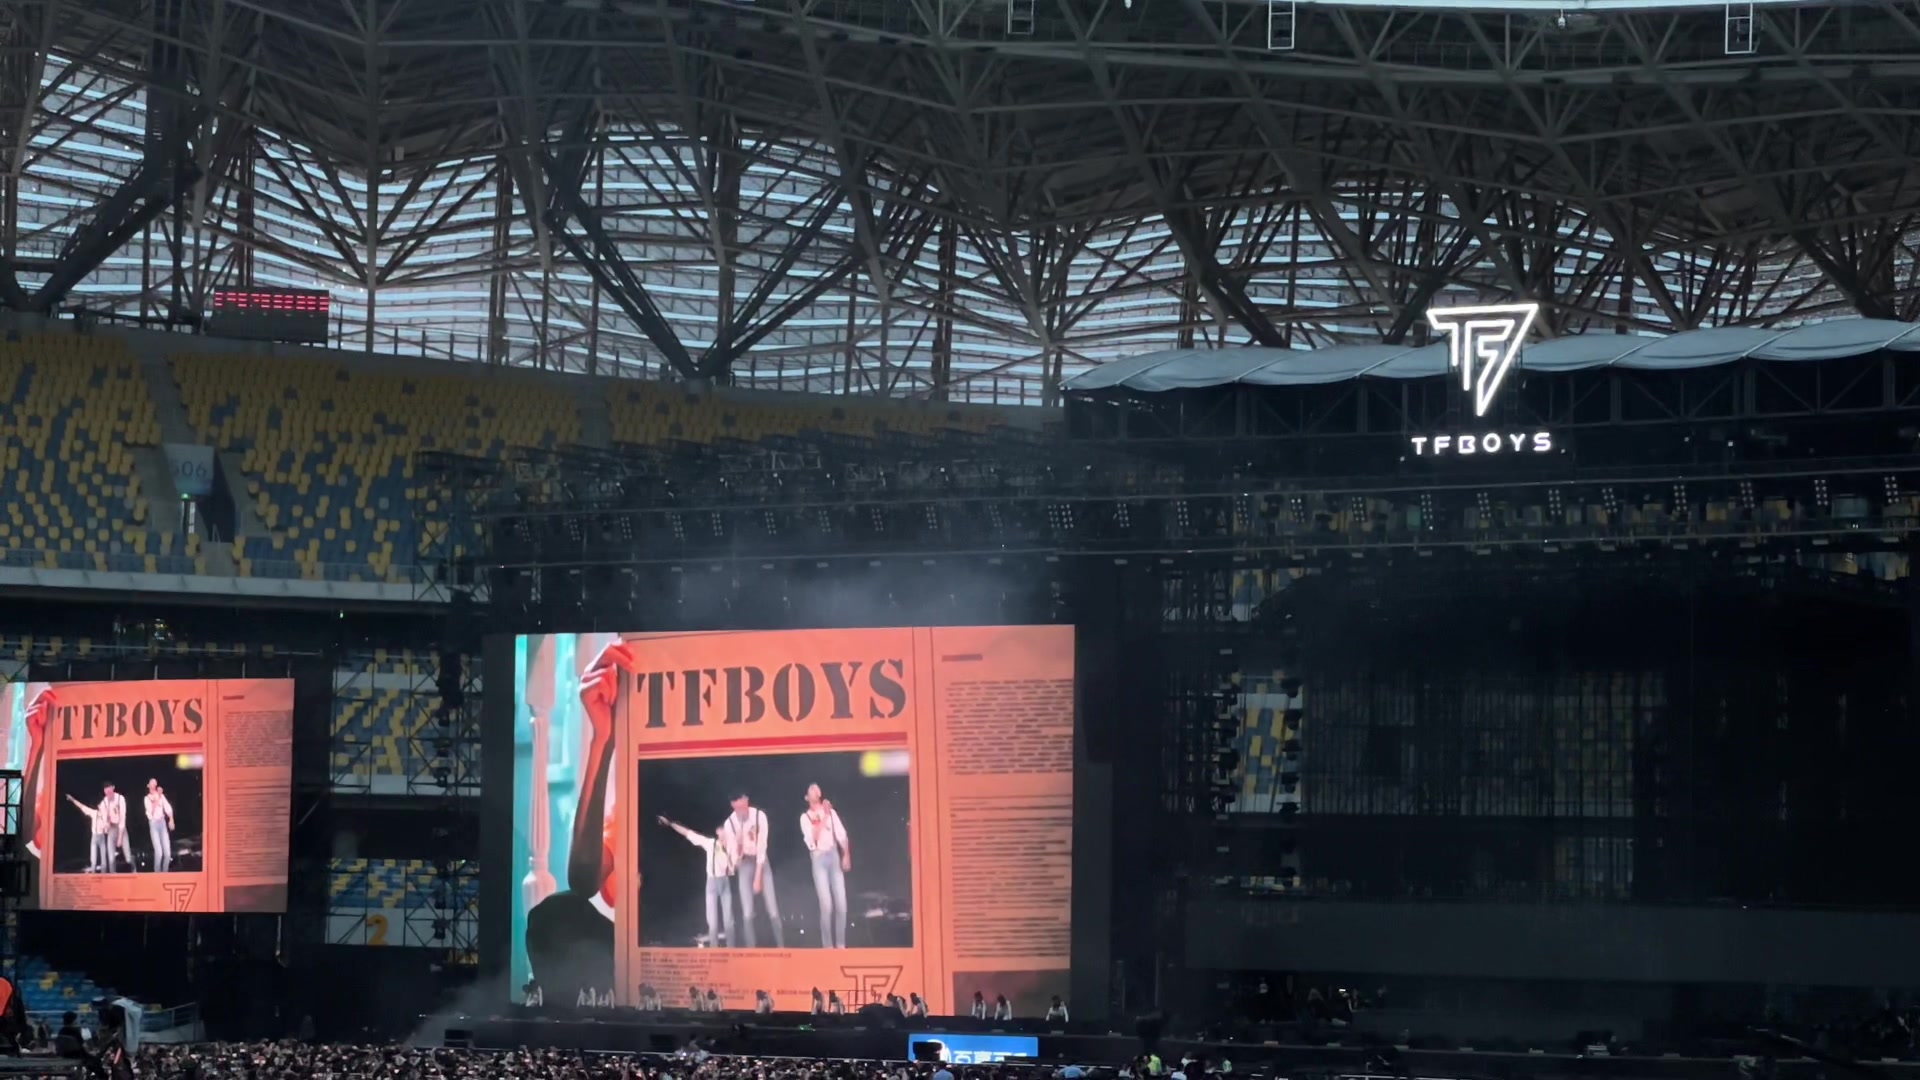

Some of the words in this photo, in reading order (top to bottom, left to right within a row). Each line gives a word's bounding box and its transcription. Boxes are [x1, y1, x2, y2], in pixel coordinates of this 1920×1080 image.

[1411, 432, 1551, 455] TFBOYS
[637, 658, 907, 729] TFBOYS
[57, 697, 204, 740] TFBOYS
